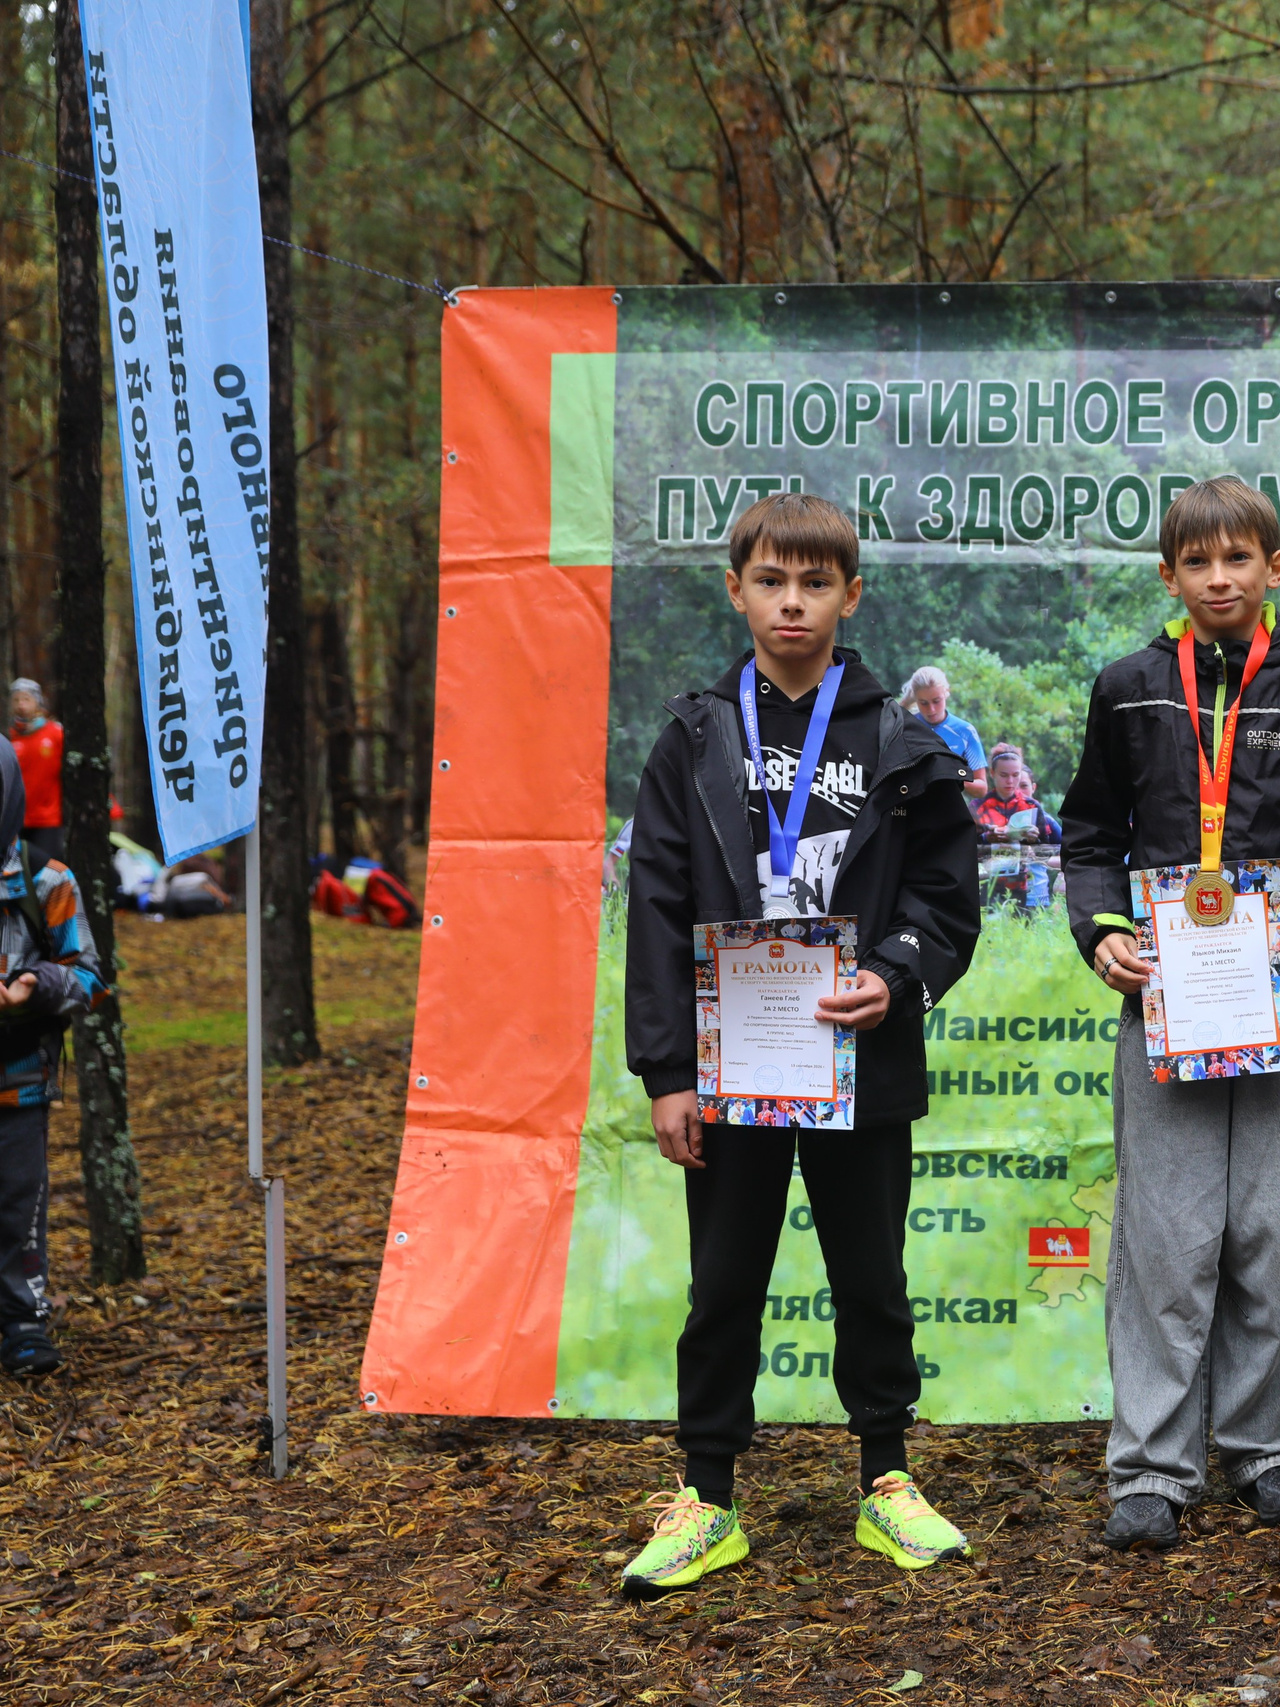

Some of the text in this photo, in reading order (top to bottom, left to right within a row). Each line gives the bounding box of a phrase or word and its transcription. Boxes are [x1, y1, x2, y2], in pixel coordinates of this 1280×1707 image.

[697, 379, 1166, 448] СПОРТИВНОЕ
[857, 474, 895, 541] К
[1218, 734, 1231, 783] ОБЛАСТЬ
[731, 961, 822, 974] ГРАМОТА
[1191, 949, 1215, 957] Языков
